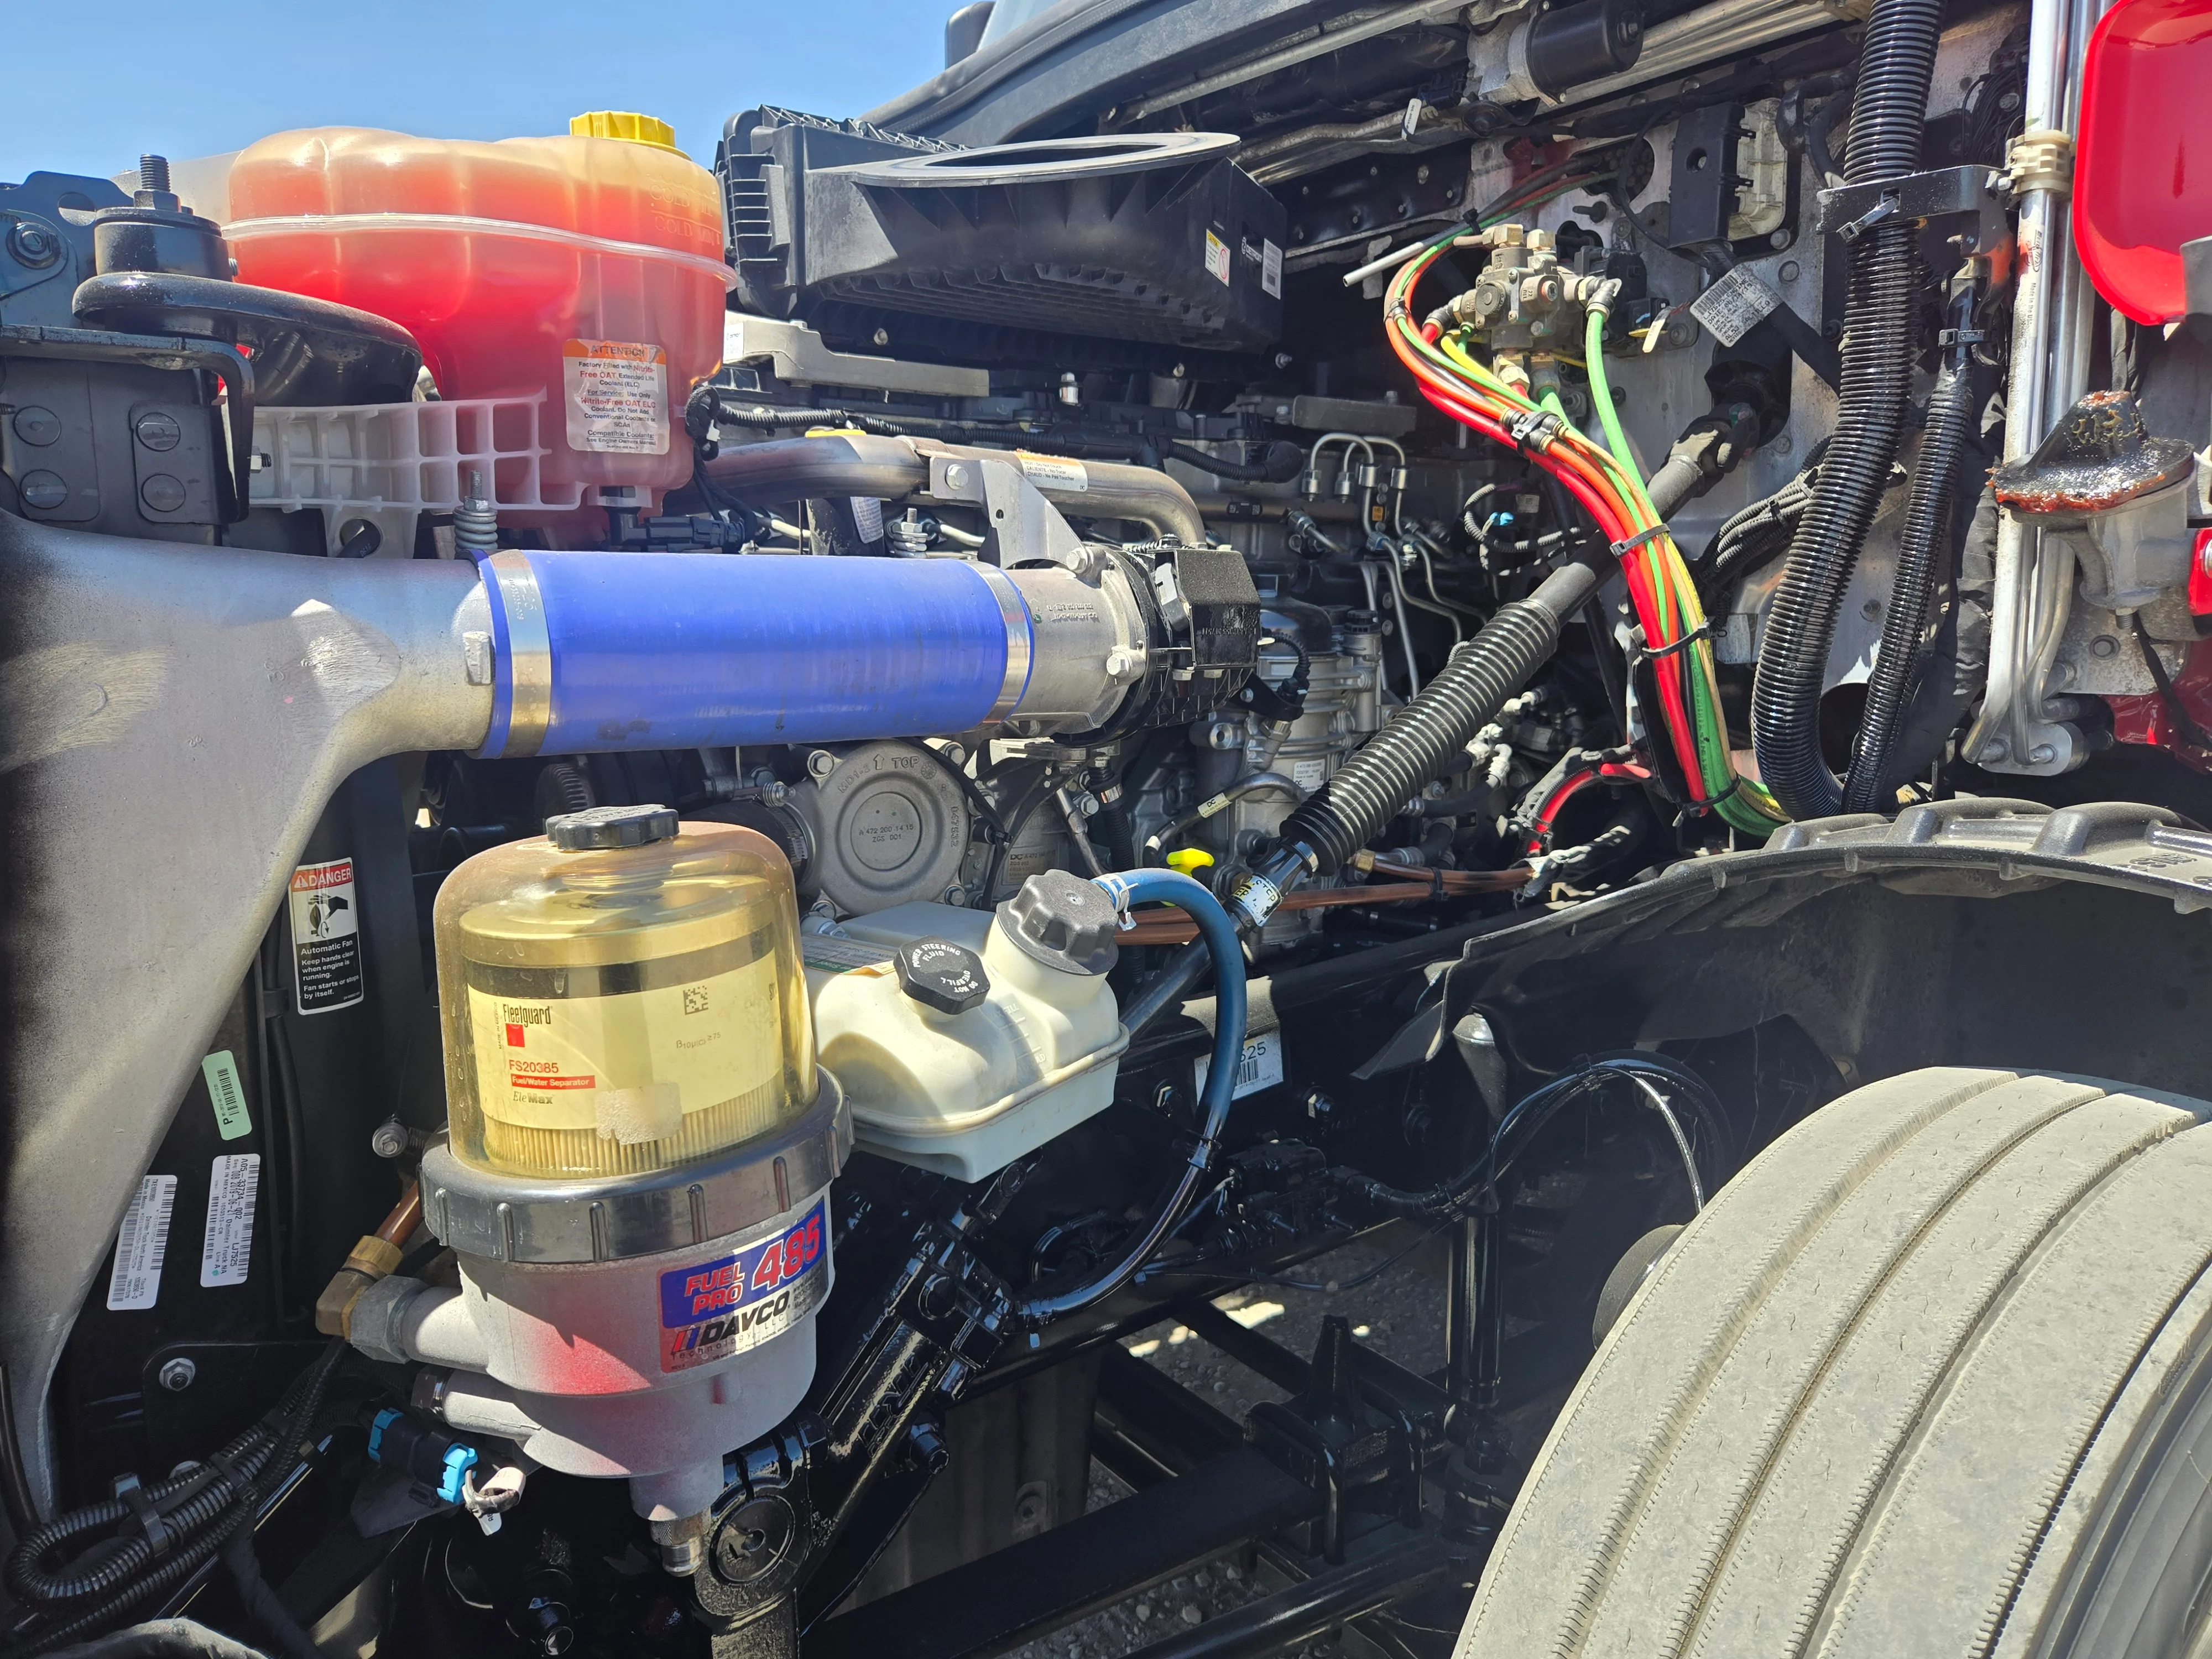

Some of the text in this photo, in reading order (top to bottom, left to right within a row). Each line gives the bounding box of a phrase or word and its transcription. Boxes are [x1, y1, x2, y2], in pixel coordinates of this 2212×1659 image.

[591, 345, 645, 356] ATTENTION
[891, 756, 920, 769] TOP
[309, 868, 352, 886] DANGER
[301, 942, 341, 956] Automatic
[322, 954, 341, 962] hands
[342, 950, 354, 958] clear
[912, 948, 923, 968] POWER
[921, 943, 961, 956] STEERING
[922, 951, 945, 961] FLUID
[322, 961, 344, 971] engine
[319, 981, 338, 989] starts
[346, 974, 359, 984] stops
[940, 970, 971, 986] OVERFILL
[968, 980, 978, 989] DO
[315, 989, 334, 998] itself.
[503, 1004, 551, 1028] Fleetguard
[509, 1059, 559, 1073] FS20385
[512, 1076, 589, 1088] Fuel/Water Separator
[230, 1243, 239, 1267] LJ7525
[751, 1213, 820, 1291] 485
[137, 1255, 145, 1271] America
[221, 1264, 227, 1274] NA
[685, 1261, 745, 1297] FUEL
[692, 1282, 743, 1316] PRO
[698, 1290, 790, 1347] DAVCO
